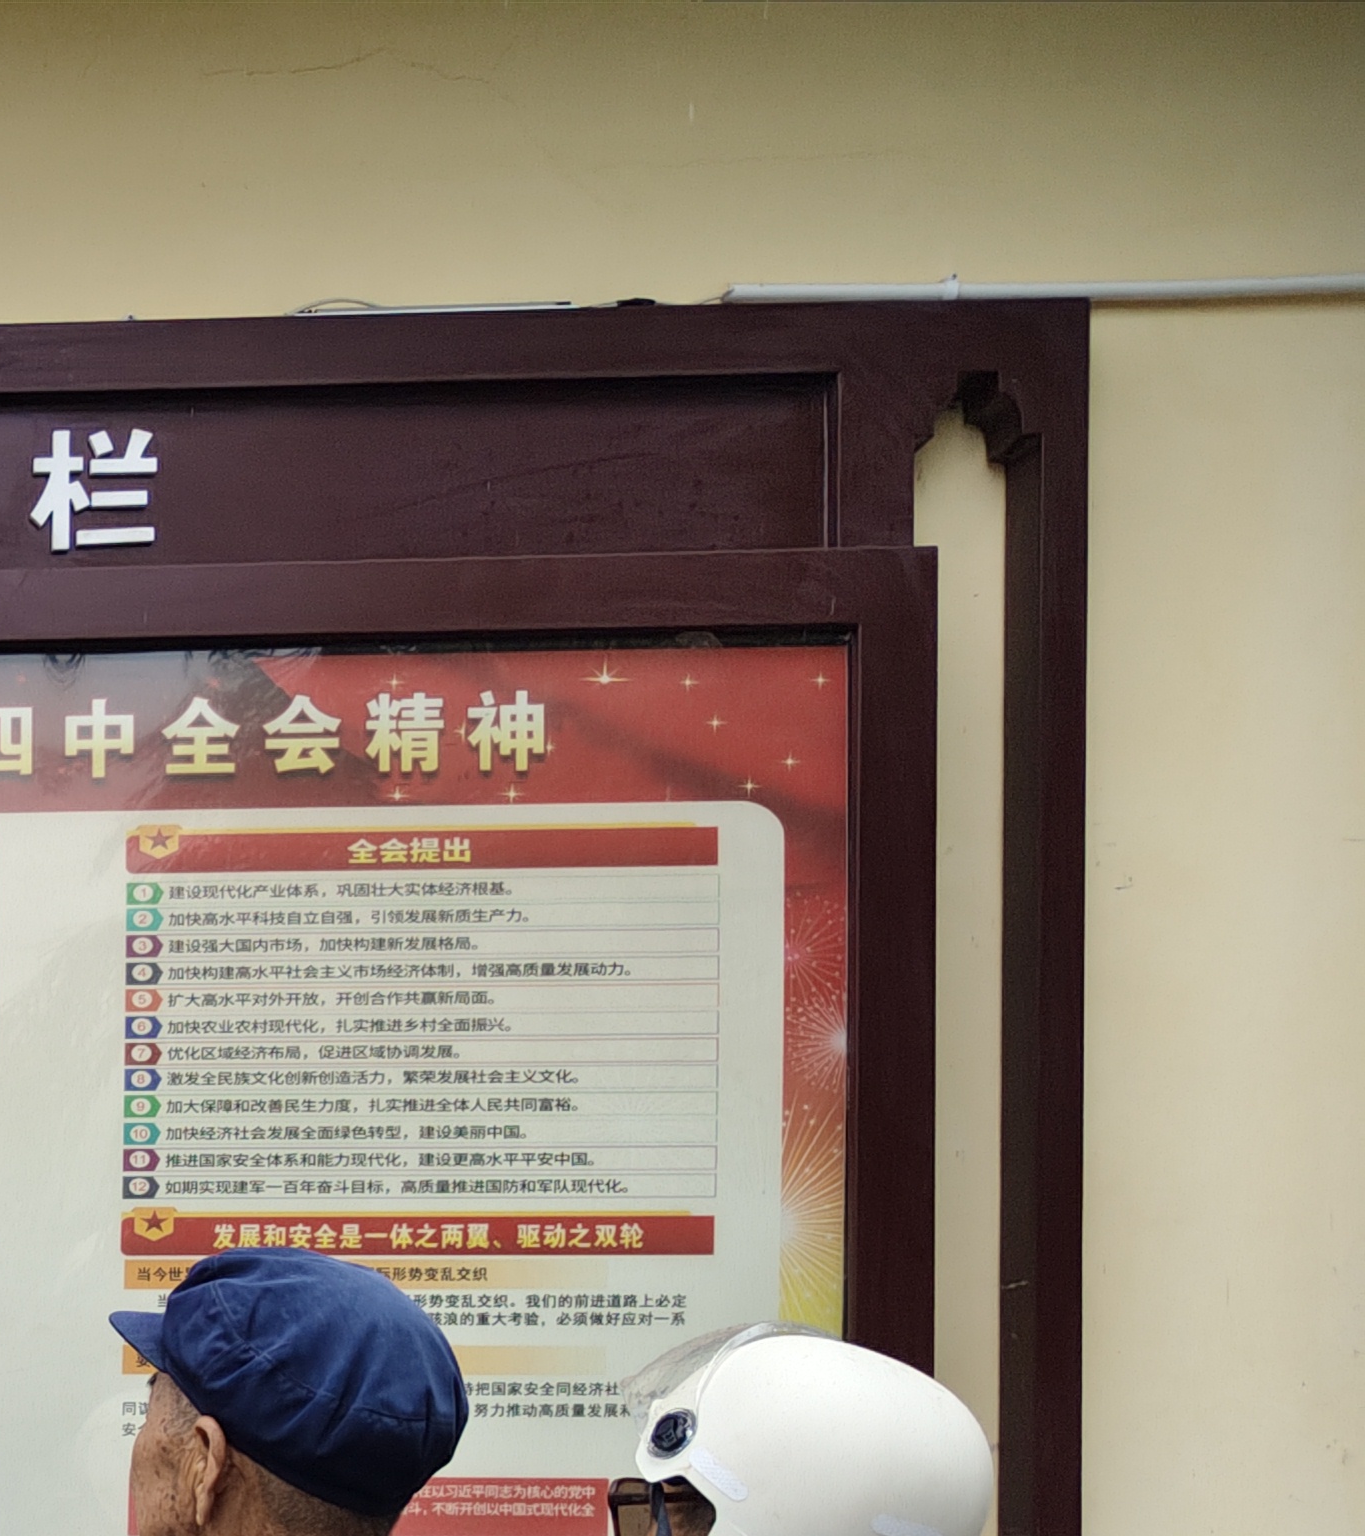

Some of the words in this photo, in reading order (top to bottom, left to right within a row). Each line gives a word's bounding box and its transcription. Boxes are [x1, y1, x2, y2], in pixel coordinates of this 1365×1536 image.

[347, 837, 472, 864] 全会提出
[169, 881, 513, 900] 建设现代化产业体系，巩固壮大实体经济根基。
[168, 909, 529, 927] 加快高水平科技自立自强，引领发展新质生产力。
[168, 937, 478, 954] 建设强大国内市场，加快构建新发展格局。
[168, 962, 631, 981] 加快构建高水平社会主义市场经济体制，增强高质量发展动力。
[167, 990, 494, 1008] 扩大高水平对外开放，开创合作共赢新局面。
[167, 1017, 511, 1035] 加快农业农村现代化，扎实推进乡村全面振兴。
[167, 1044, 460, 1061] 优化区域经济布局，促进区域协调发展。
[166, 1070, 579, 1087] 激发全民族文化创新创造活力，繁荣发展社会主义文化。
[166, 1098, 578, 1115] 加大保障和改善民生力度，扎实推进全体人民共同富裕。
[166, 1125, 526, 1141] 加快经济社会发展全面绿色转型，建设美丽中国。
[165, 1152, 595, 1168] 推进国家安全体系和能力现代化，建设更高水平平安中国。
[165, 1179, 628, 1196] 如期实现建军一百年奋斗目标，高质量推进国防和军队现代化。
[213, 1222, 645, 1250] 发展和安全是一体之两翼、驱动之双轮
[370, 1266, 488, 1282] 际形势变乱交织
